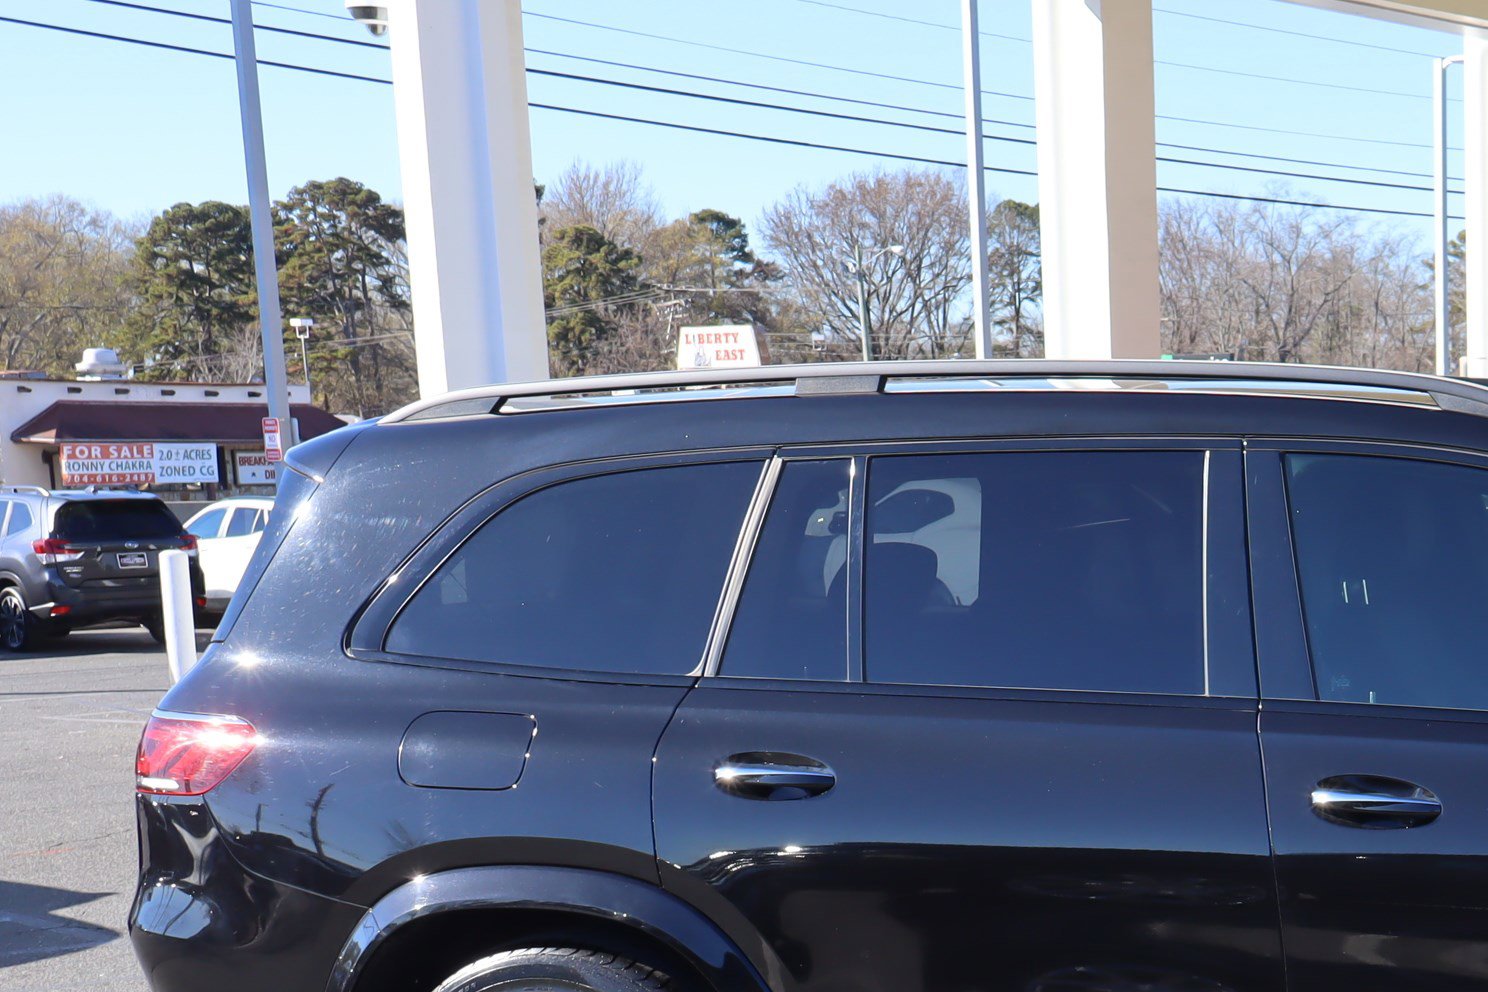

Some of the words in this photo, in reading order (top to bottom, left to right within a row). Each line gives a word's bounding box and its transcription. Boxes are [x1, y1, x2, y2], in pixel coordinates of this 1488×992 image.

[685, 332, 739, 345] LIBERTY
[715, 349, 746, 361] EAST
[63, 445, 101, 459] FOR
[109, 445, 152, 459] SALE
[159, 450, 172, 461] 2.0
[183, 449, 212, 460] ACRES
[65, 460, 105, 472] RONNY
[108, 460, 152, 471] CHAKRA
[160, 465, 196, 477] ZONED
[199, 465, 215, 476] CG
[67, 474, 152, 484] 704-616-2487
